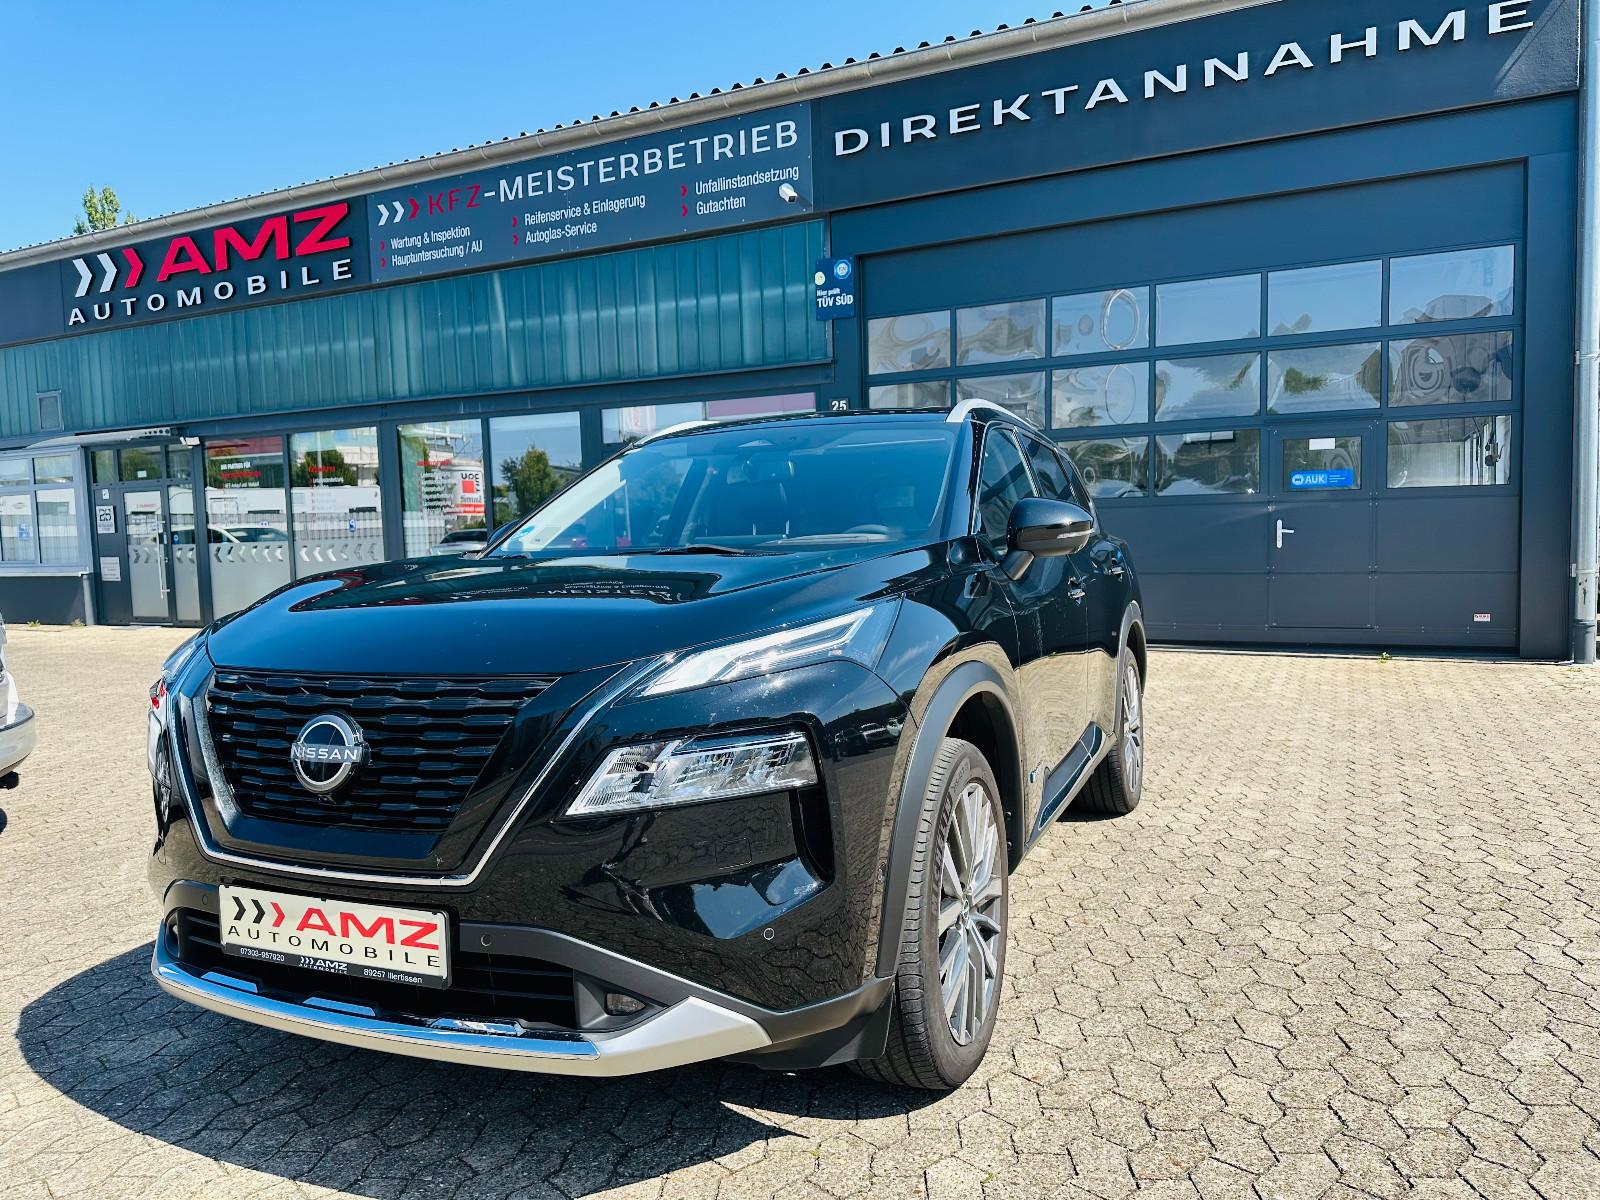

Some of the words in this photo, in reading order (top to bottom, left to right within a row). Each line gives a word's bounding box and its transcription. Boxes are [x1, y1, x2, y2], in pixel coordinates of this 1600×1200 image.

[834, 0, 1534, 156] DIREKTANNAHME
[427, 120, 798, 216] KFZ-MEISTERBETRIEB
[695, 166, 799, 195] Unfallinstandsetzung
[524, 205, 581, 226] Reifenservice
[583, 202, 591, 215] &
[592, 195, 646, 213] Einlagerung
[696, 195, 746, 215] Gutachten
[157, 202, 351, 282] AMZ
[390, 235, 422, 250] Wartung
[423, 231, 430, 244] &
[431, 225, 471, 243] Inspektion
[525, 221, 598, 245] Autoglas-Service
[391, 244, 465, 267] Hauptuntersuchung
[471, 239, 483, 253] AU
[68, 258, 352, 326] AUTOMOBILE
[816, 296, 834, 308] TÜV
[835, 293, 854, 306] SÜD
[831, 400, 847, 411] 25
[291, 743, 358, 760] NISSAN
[296, 907, 440, 951] AMZ
[228, 925, 441, 968] AUTOMOBILE
[316, 959, 348, 971] AMZ
[363, 968, 386, 978] 89257
[387, 971, 423, 984] Illertissen
